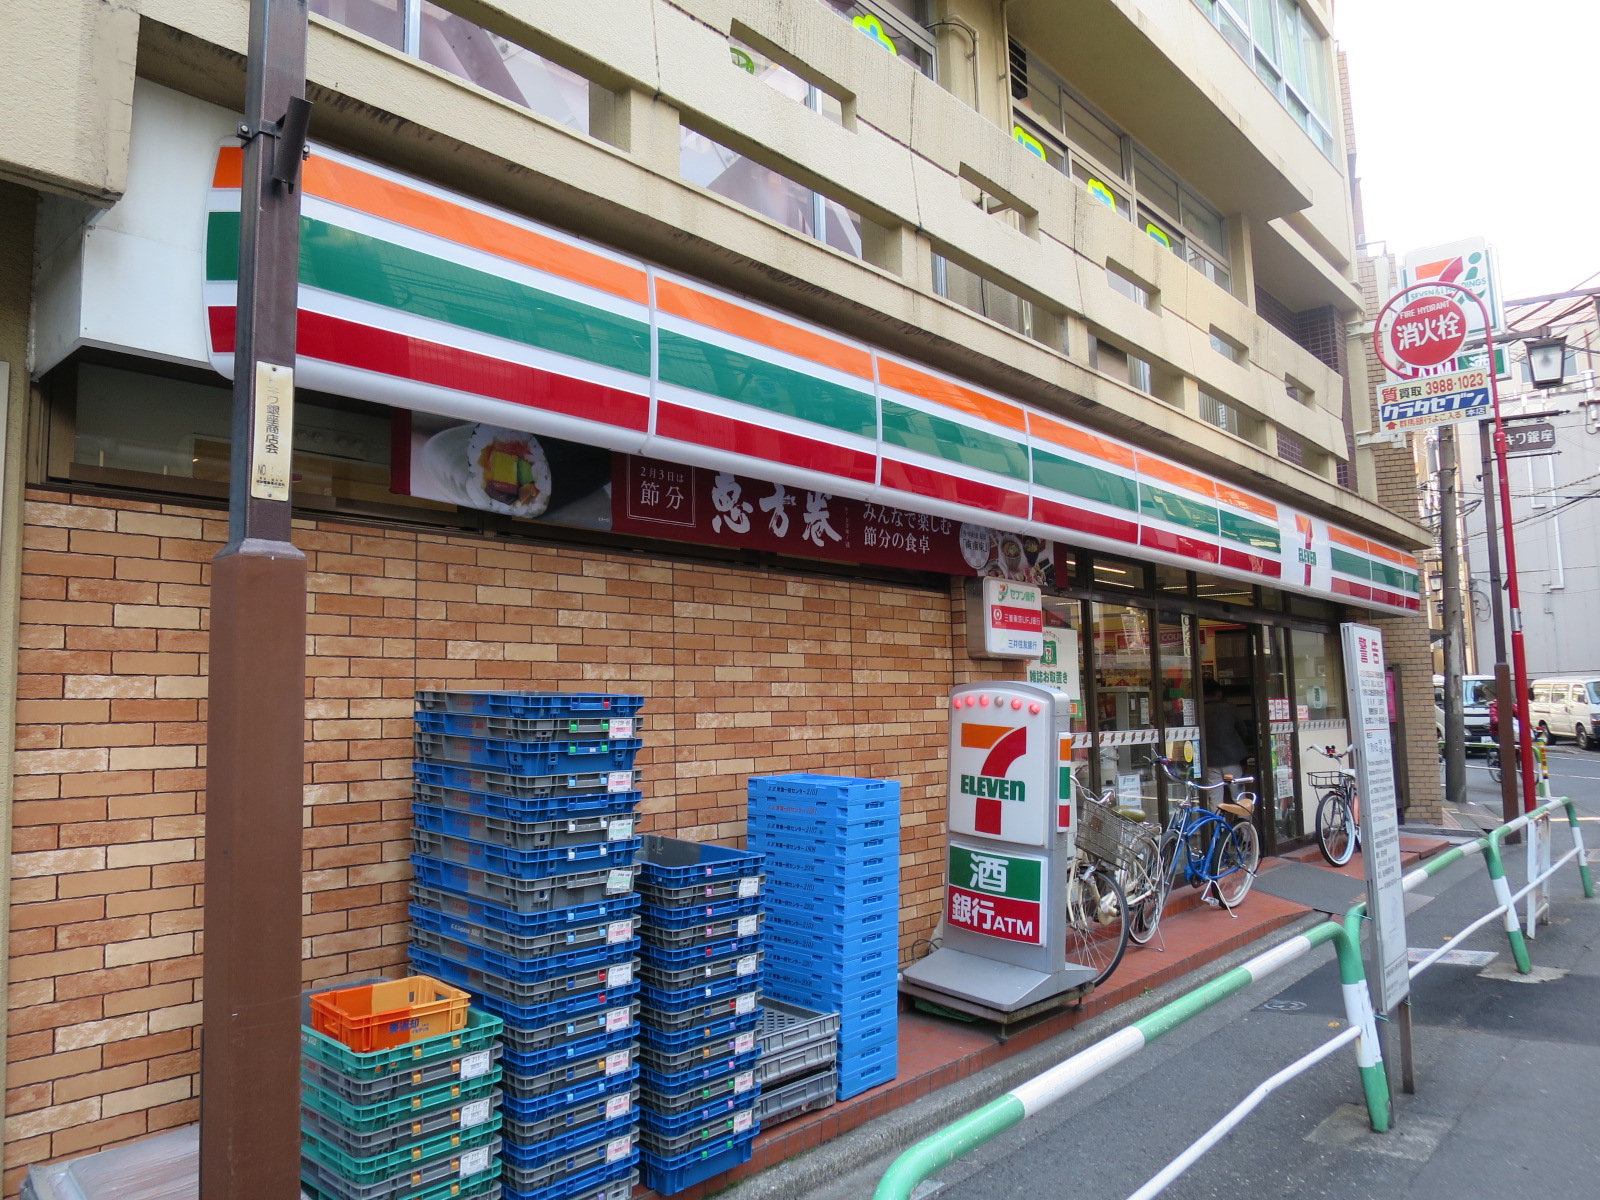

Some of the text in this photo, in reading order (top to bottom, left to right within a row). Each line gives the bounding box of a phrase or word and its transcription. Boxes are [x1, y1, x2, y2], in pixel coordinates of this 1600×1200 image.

[1445, 277, 1487, 295] HODINGS
[1399, 300, 1450, 319] FIRE HYDRANT
[1396, 311, 1462, 351] 消火栓
[1381, 386, 1398, 404] 質
[1399, 386, 1422, 400] 買取
[1383, 392, 1486, 420] クラタセブン
[1466, 406, 1487, 417] 本店
[1504, 429, 1554, 446] キワ銀座
[640, 466, 685, 483] 2月3日は
[640, 480, 685, 510] 節分
[711, 471, 843, 547] 恵方巻
[863, 501, 952, 535] みんなで楽しむ
[864, 526, 931, 554] 節分の食卓
[1010, 588, 1036, 602] セブン銀行
[1004, 613, 1041, 625] 三菱東京UFJ銀行
[1008, 639, 1038, 650] 三井住友銀行
[1029, 669, 1068, 684] 雑誌お取置き
[969, 852, 1009, 893] 酒
[952, 892, 1033, 937] 銀行ATM
